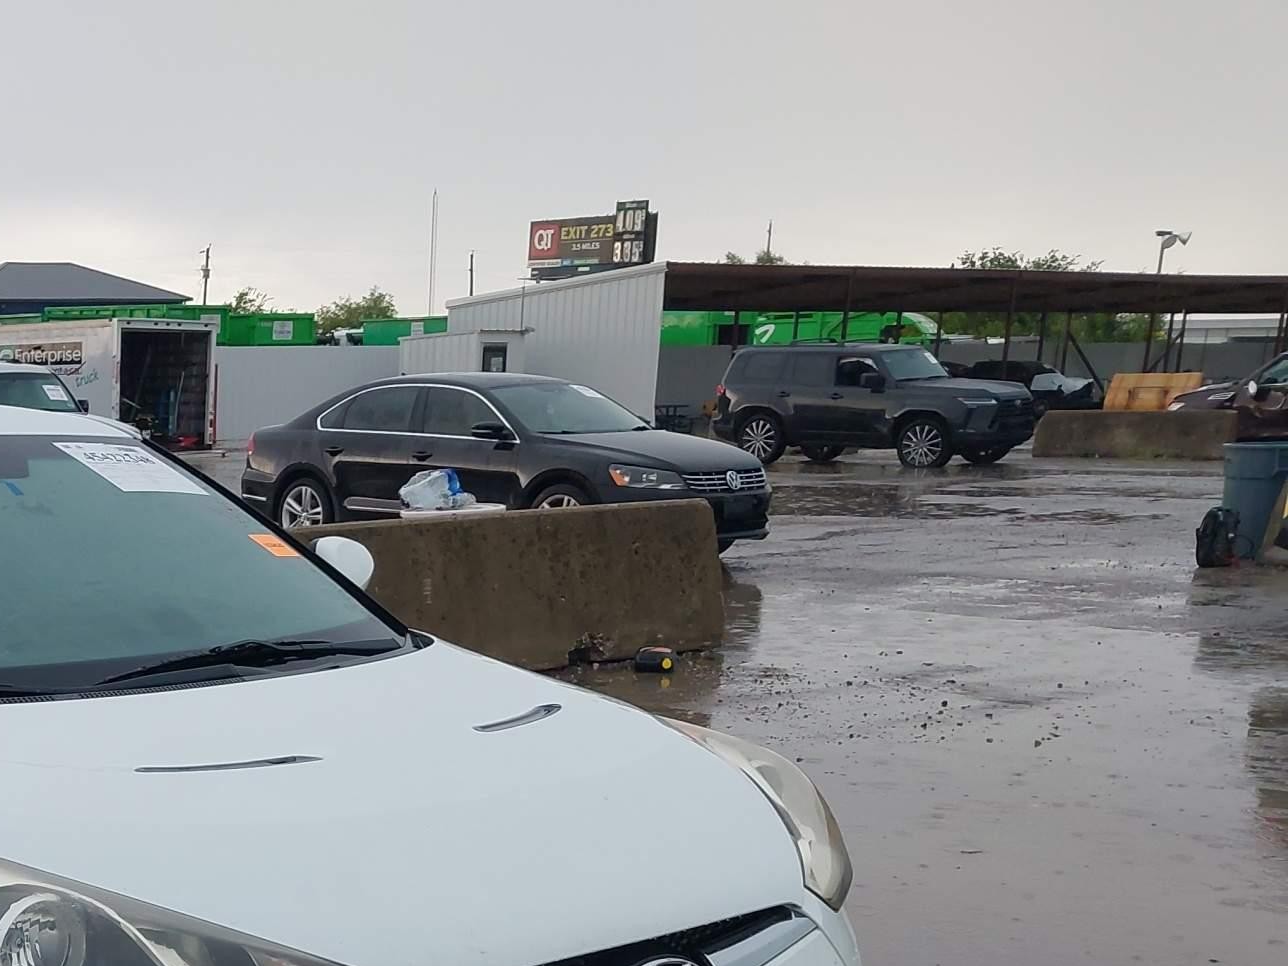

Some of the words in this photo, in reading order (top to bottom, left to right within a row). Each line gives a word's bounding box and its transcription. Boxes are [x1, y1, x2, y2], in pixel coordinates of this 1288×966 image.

[535, 230, 554, 250] QT
[561, 226, 588, 239] EXIT
[591, 224, 613, 237] 273
[14, 344, 82, 366] Enterprise
